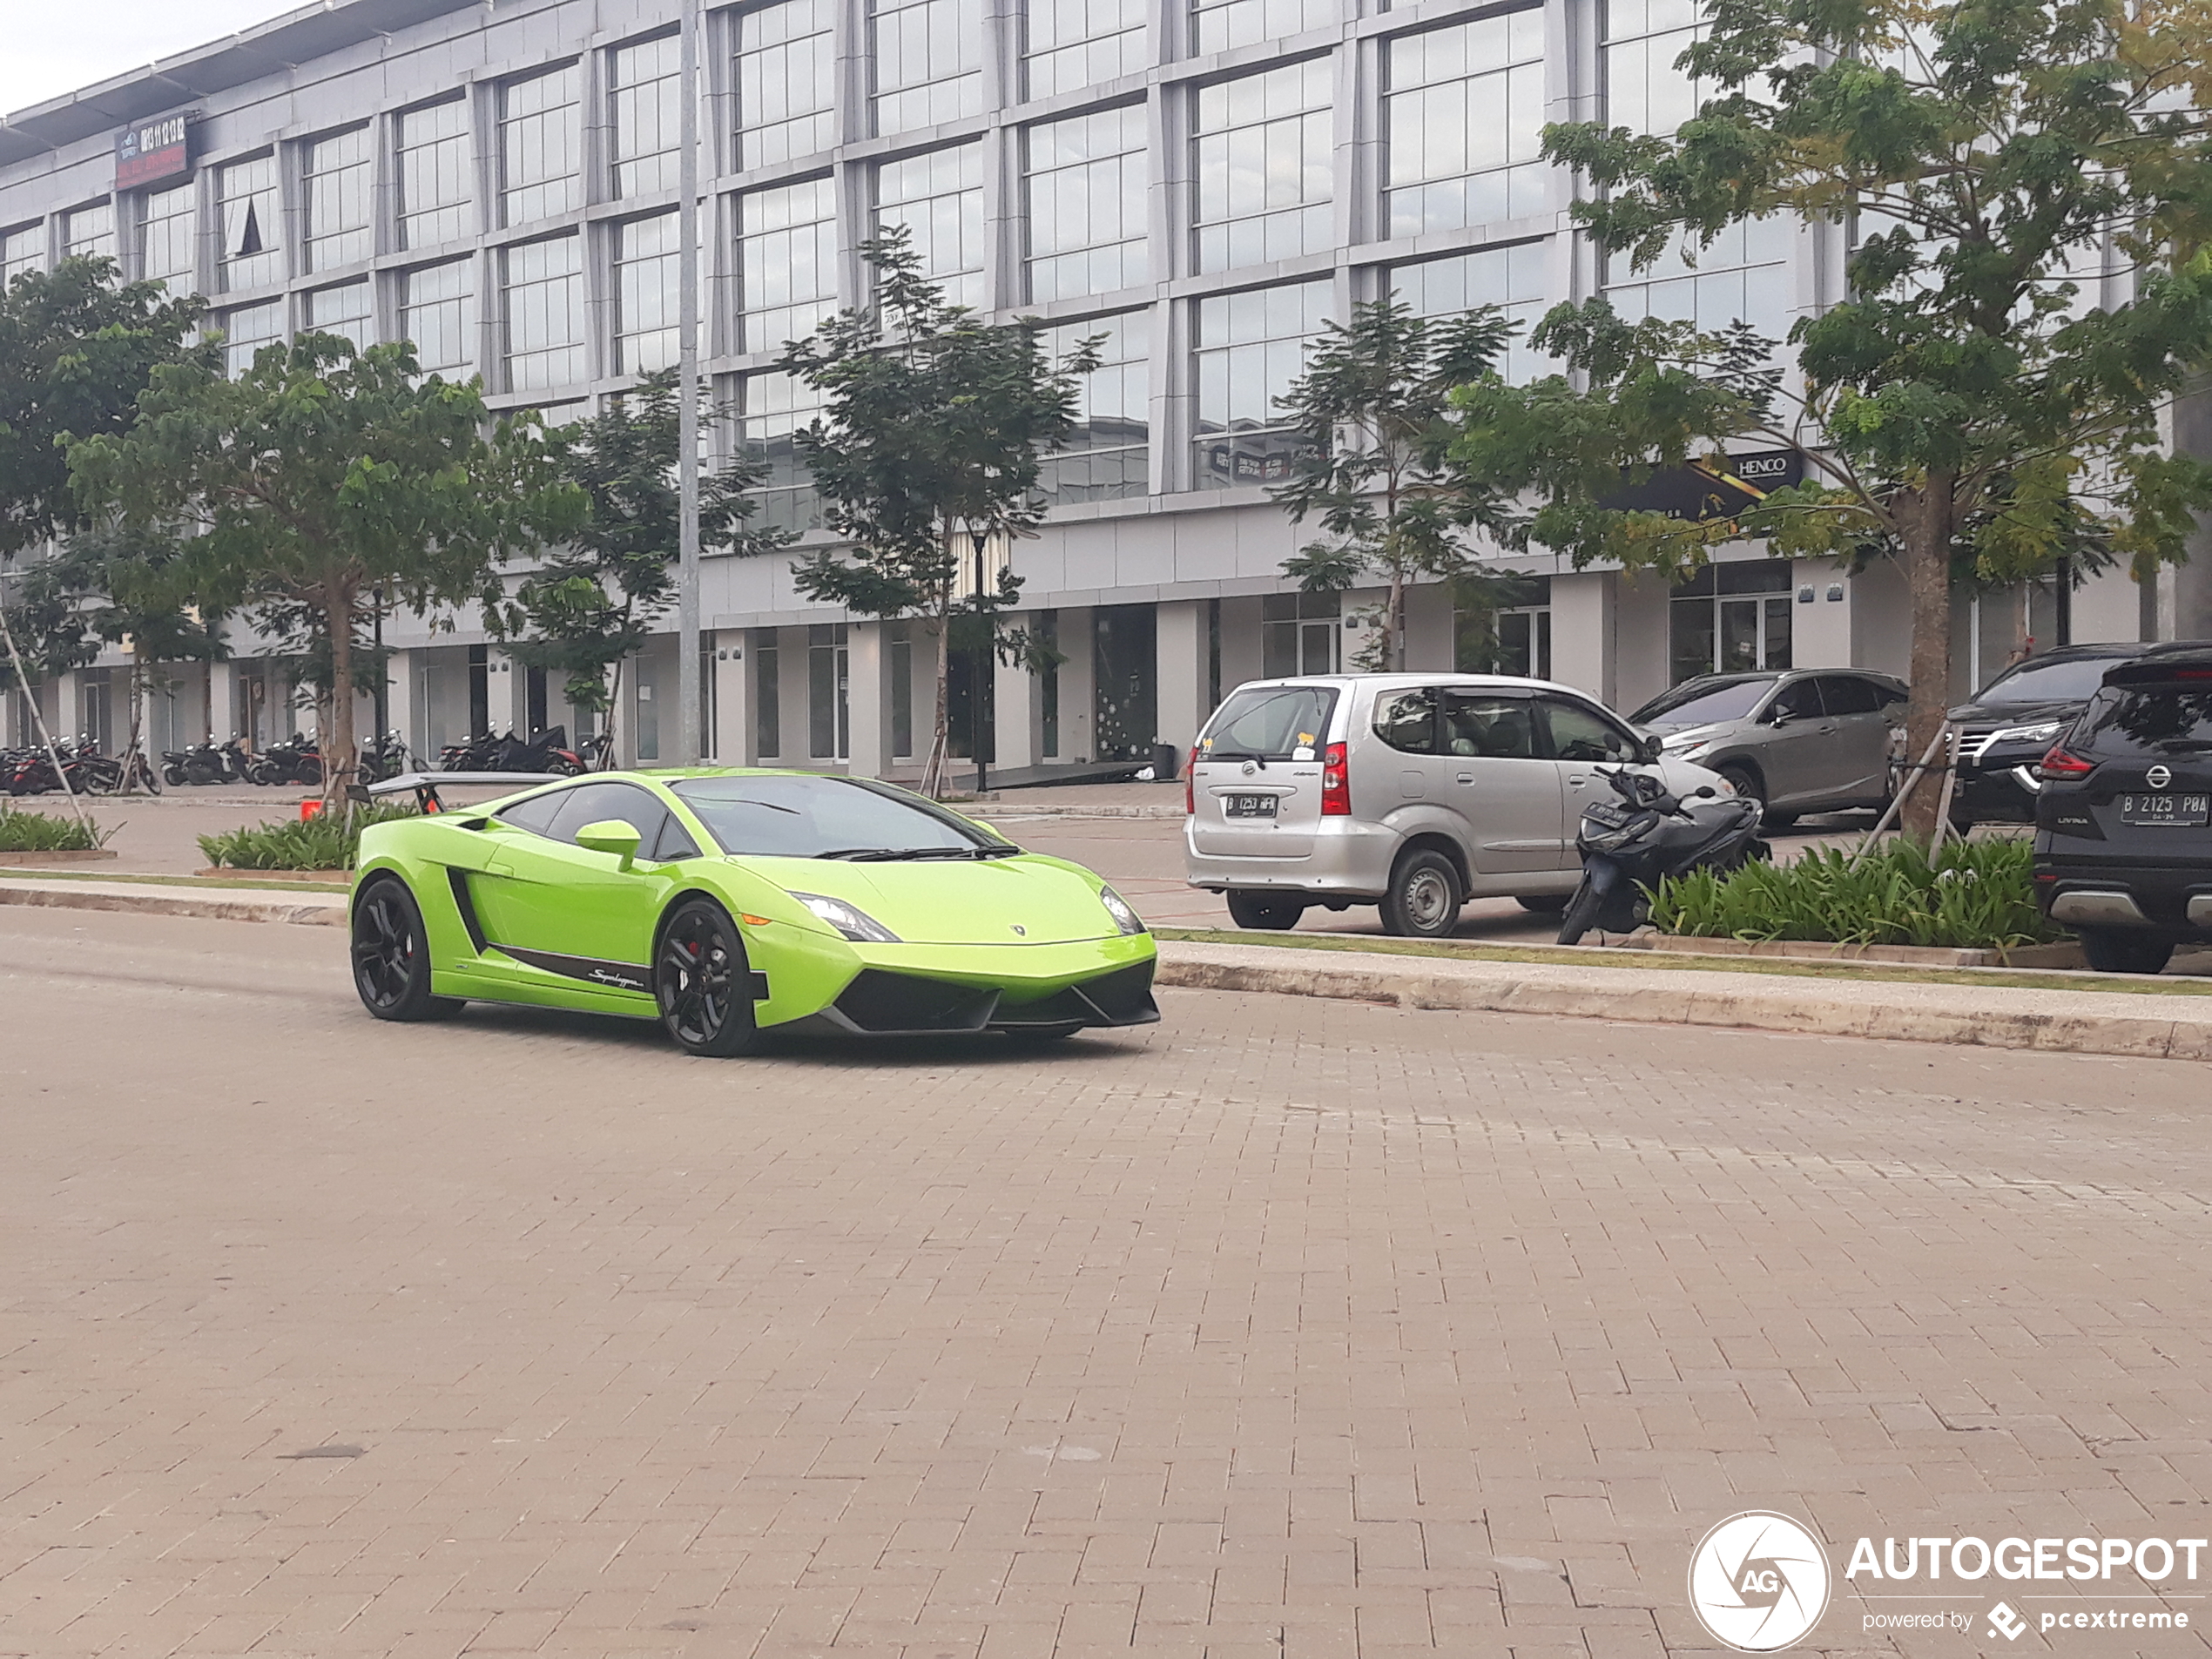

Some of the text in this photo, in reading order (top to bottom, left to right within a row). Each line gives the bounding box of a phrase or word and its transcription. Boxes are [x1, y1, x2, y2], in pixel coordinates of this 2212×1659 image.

[1739, 457, 1786, 475] HENCO
[1228, 797, 1234, 810] B
[1239, 797, 1258, 810] 1253
[2125, 796, 2133, 812] B
[2141, 796, 2173, 812] 2125
